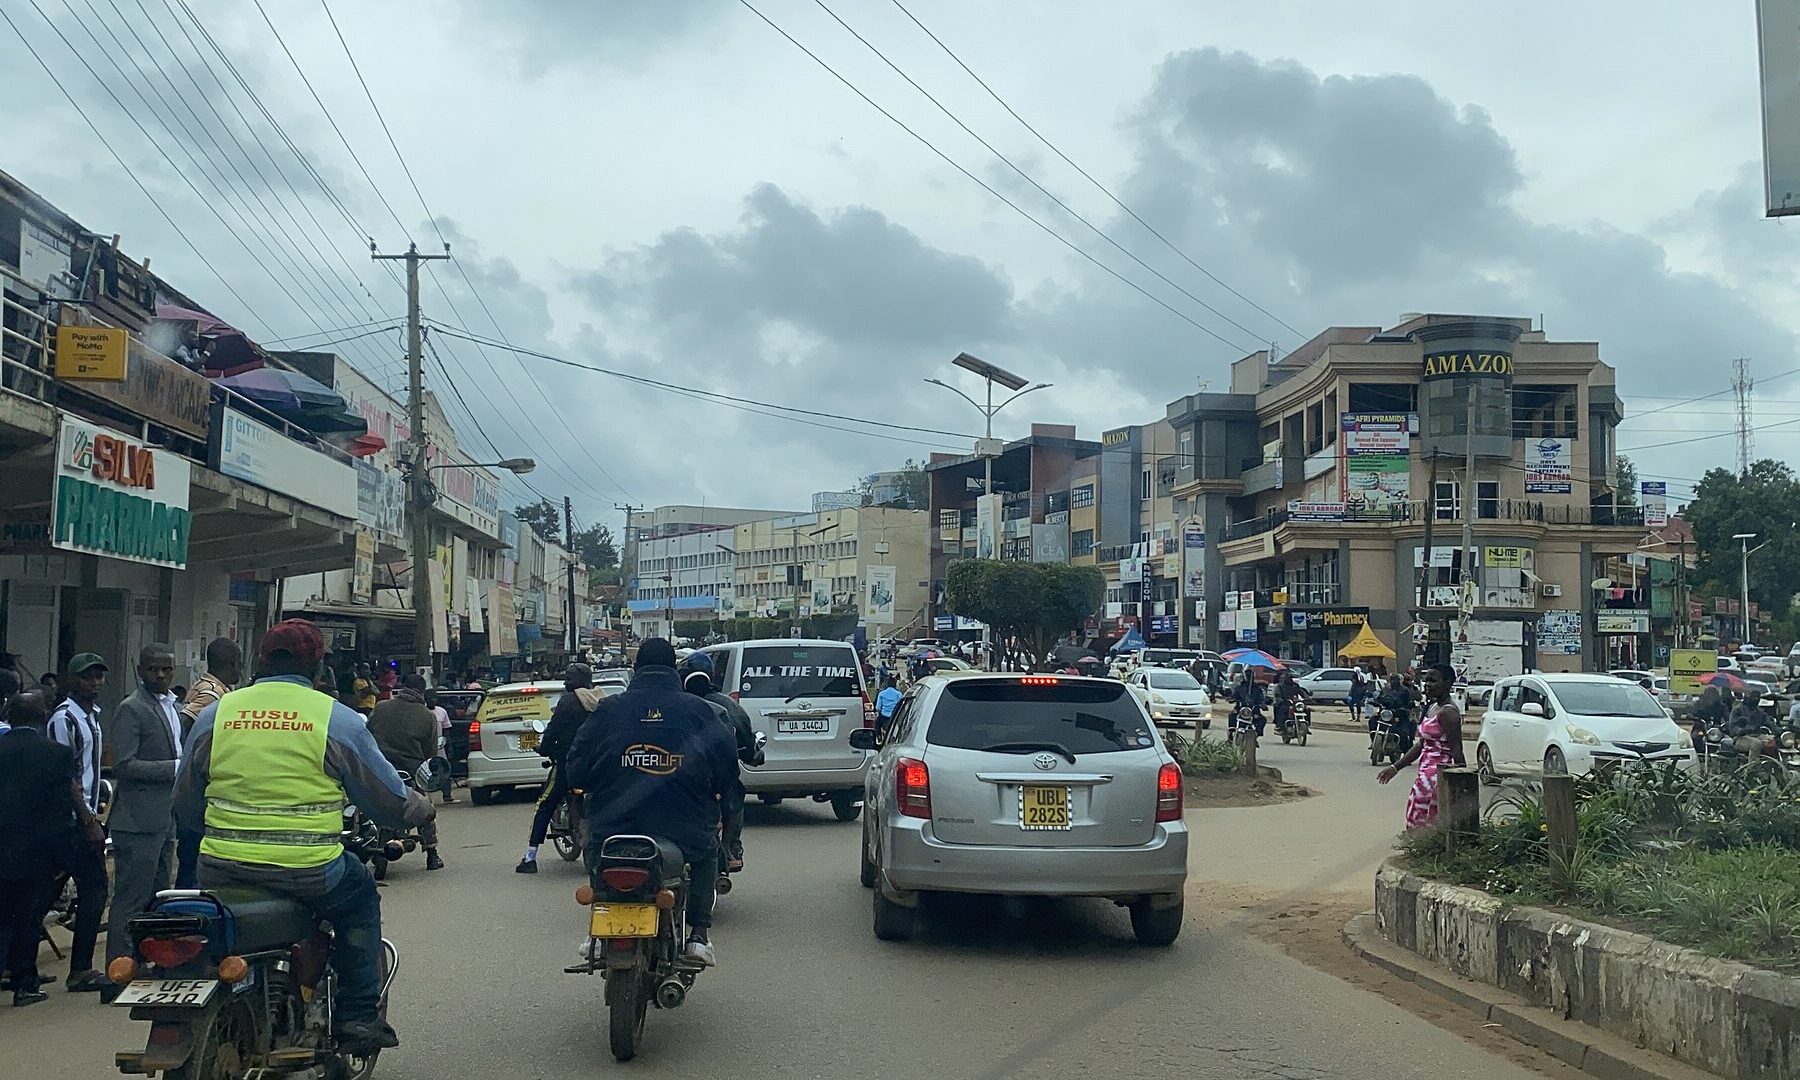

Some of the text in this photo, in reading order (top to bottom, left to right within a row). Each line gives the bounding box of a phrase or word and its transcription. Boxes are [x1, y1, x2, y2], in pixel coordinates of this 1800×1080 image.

[72, 333, 88, 342] Pay
[77, 342, 103, 350] MoMo
[1424, 354, 1514, 377] AMAZON
[1355, 415, 1406, 423] AFRI PYRAMIDS
[92, 433, 155, 490] SILVA
[55, 474, 192, 567] PHARMACY
[1324, 611, 1368, 626] Pharmacy
[742, 665, 855, 678] ALL THE TIME
[237, 710, 298, 720] TUSU
[223, 720, 314, 731] PETROLEUM
[789, 721, 823, 730] UA 144CJ
[621, 754, 685, 767] INTERLIFT
[1037, 789, 1065, 806] UBL
[1029, 807, 1065, 823] 282S
[160, 981, 208, 992] UFF
